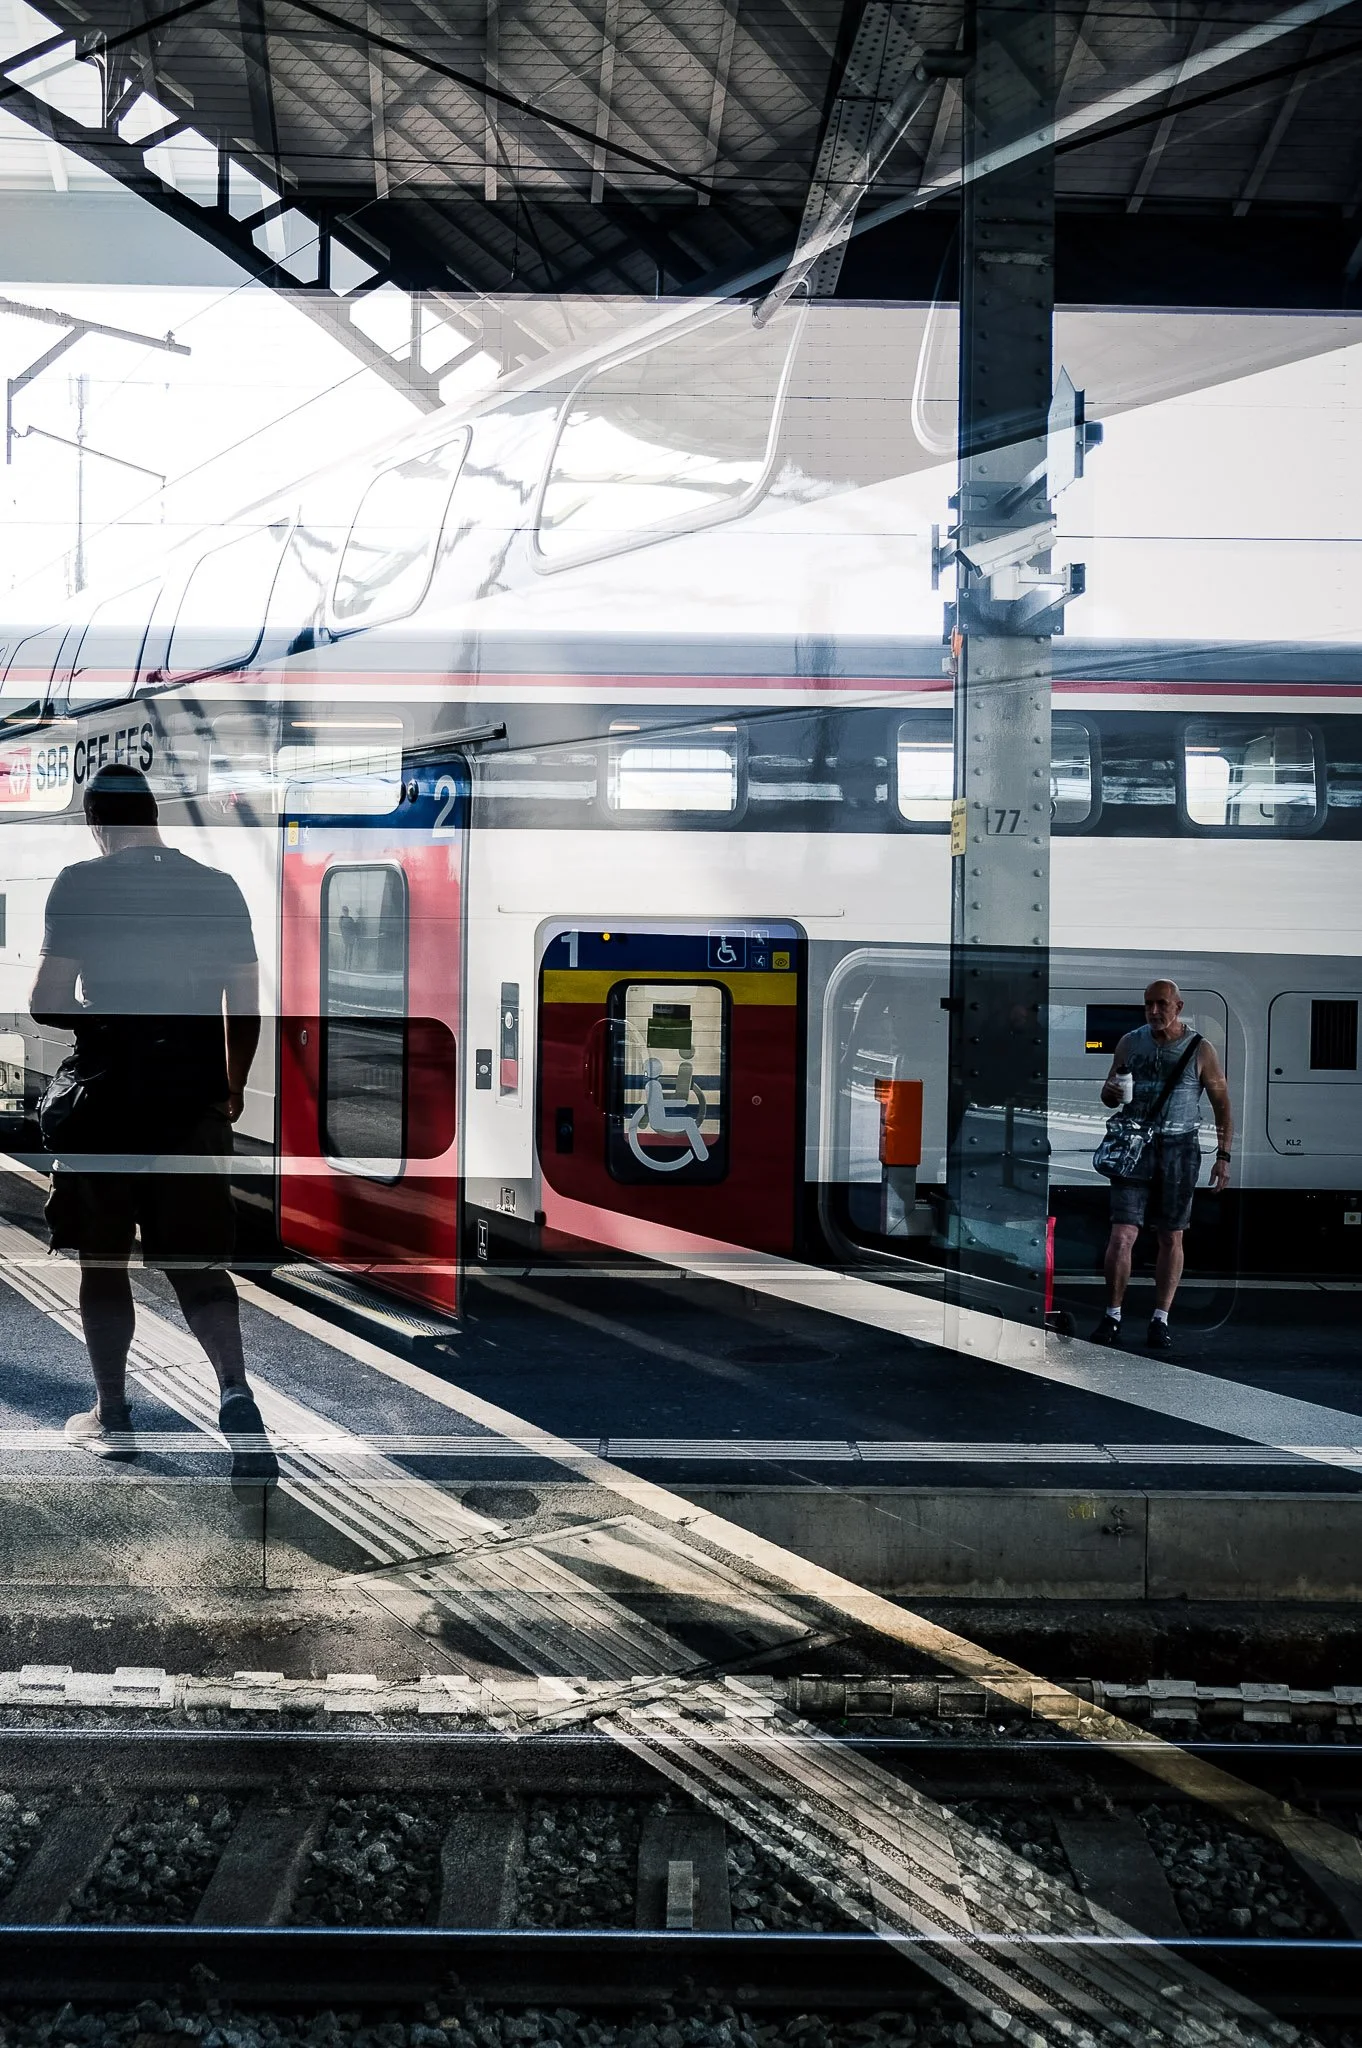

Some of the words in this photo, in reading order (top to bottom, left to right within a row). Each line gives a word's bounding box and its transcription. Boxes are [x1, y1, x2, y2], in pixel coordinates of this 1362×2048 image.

[36, 745, 69, 791] SBB
[115, 722, 154, 772] FFS
[431, 774, 457, 838] 2
[994, 809, 1021, 834] 77
[560, 928, 579, 968] 1
